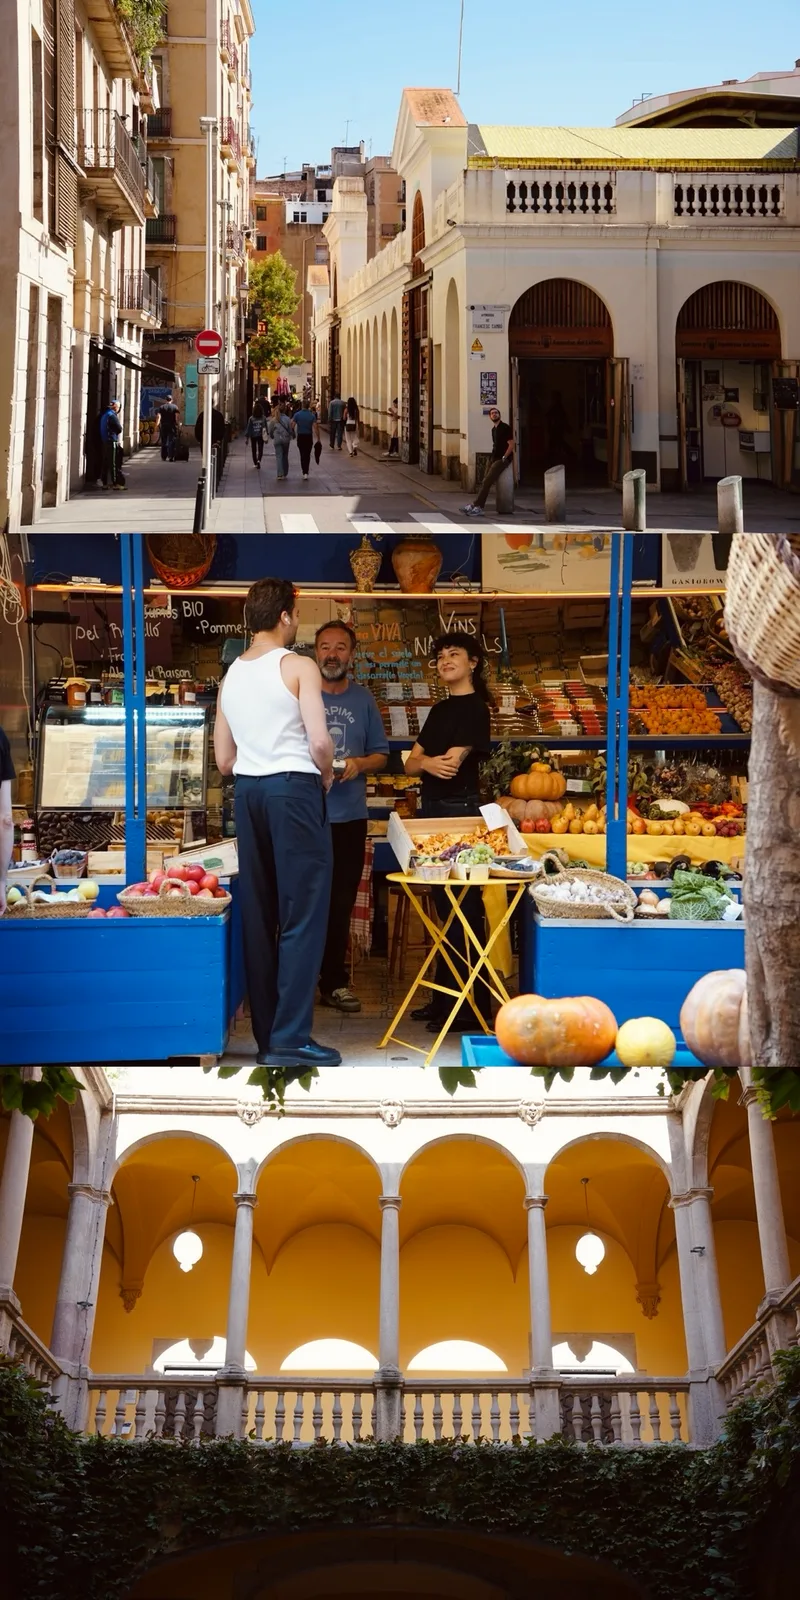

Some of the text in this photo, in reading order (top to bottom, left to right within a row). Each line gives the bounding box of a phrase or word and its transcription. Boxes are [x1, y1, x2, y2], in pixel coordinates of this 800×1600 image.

[182, 600, 204, 618] BIO
[75, 624, 100, 641] Del
[370, 622, 401, 641] VIVA
